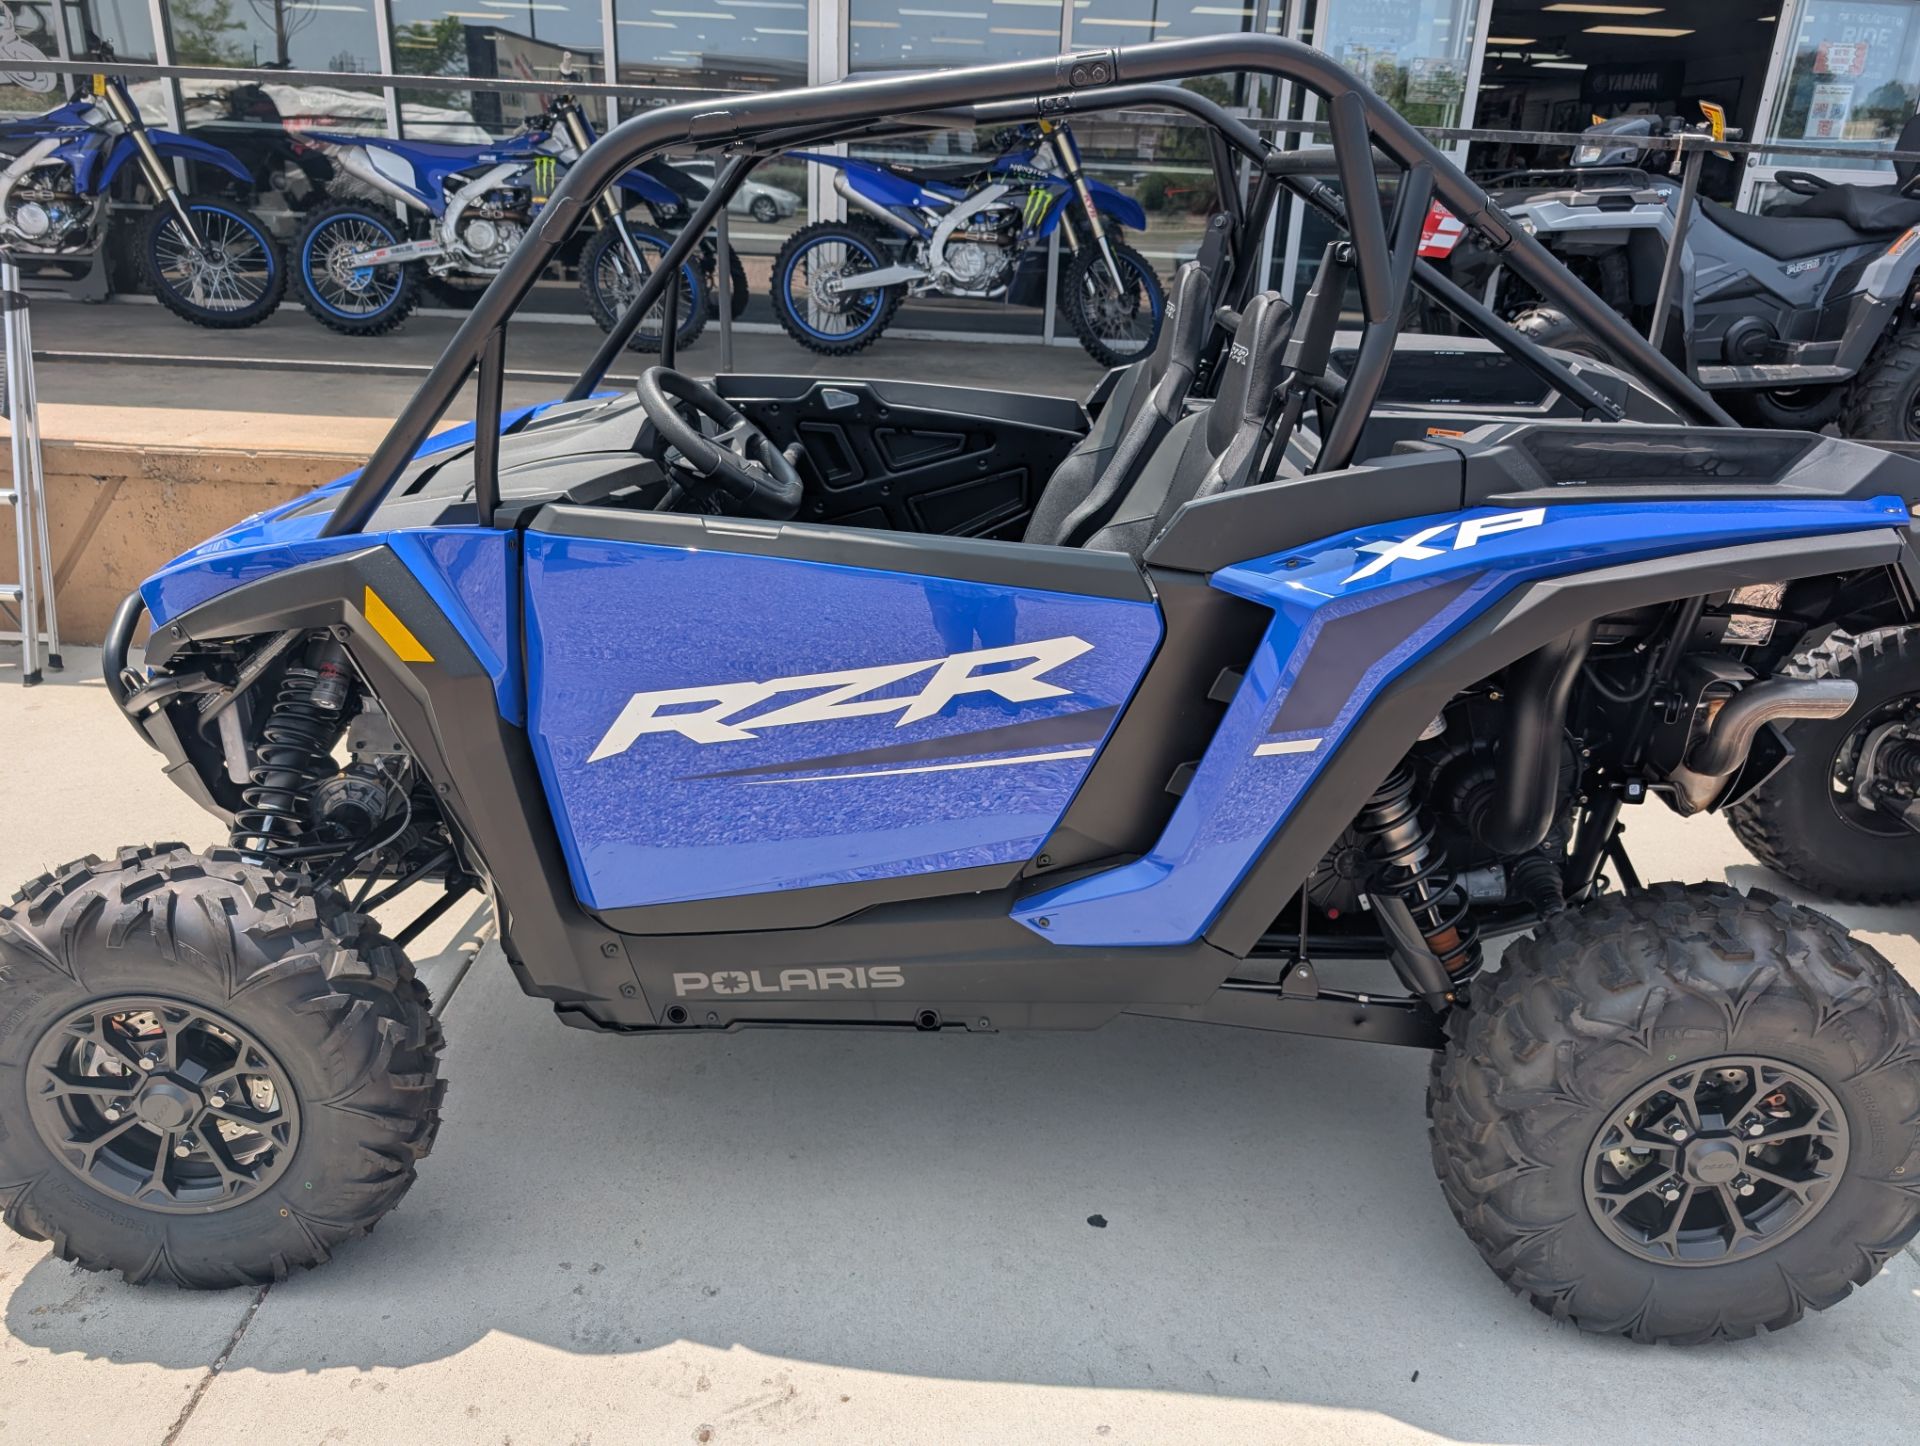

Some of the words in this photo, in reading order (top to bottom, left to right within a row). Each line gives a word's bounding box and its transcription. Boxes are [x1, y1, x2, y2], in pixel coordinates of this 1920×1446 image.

[1841, 25, 1892, 48] RIDE
[1609, 72, 1658, 91] YAMAHA
[1340, 508, 1546, 584] XP
[586, 635, 1095, 763] RZR
[672, 965, 905, 997] POLARIS
